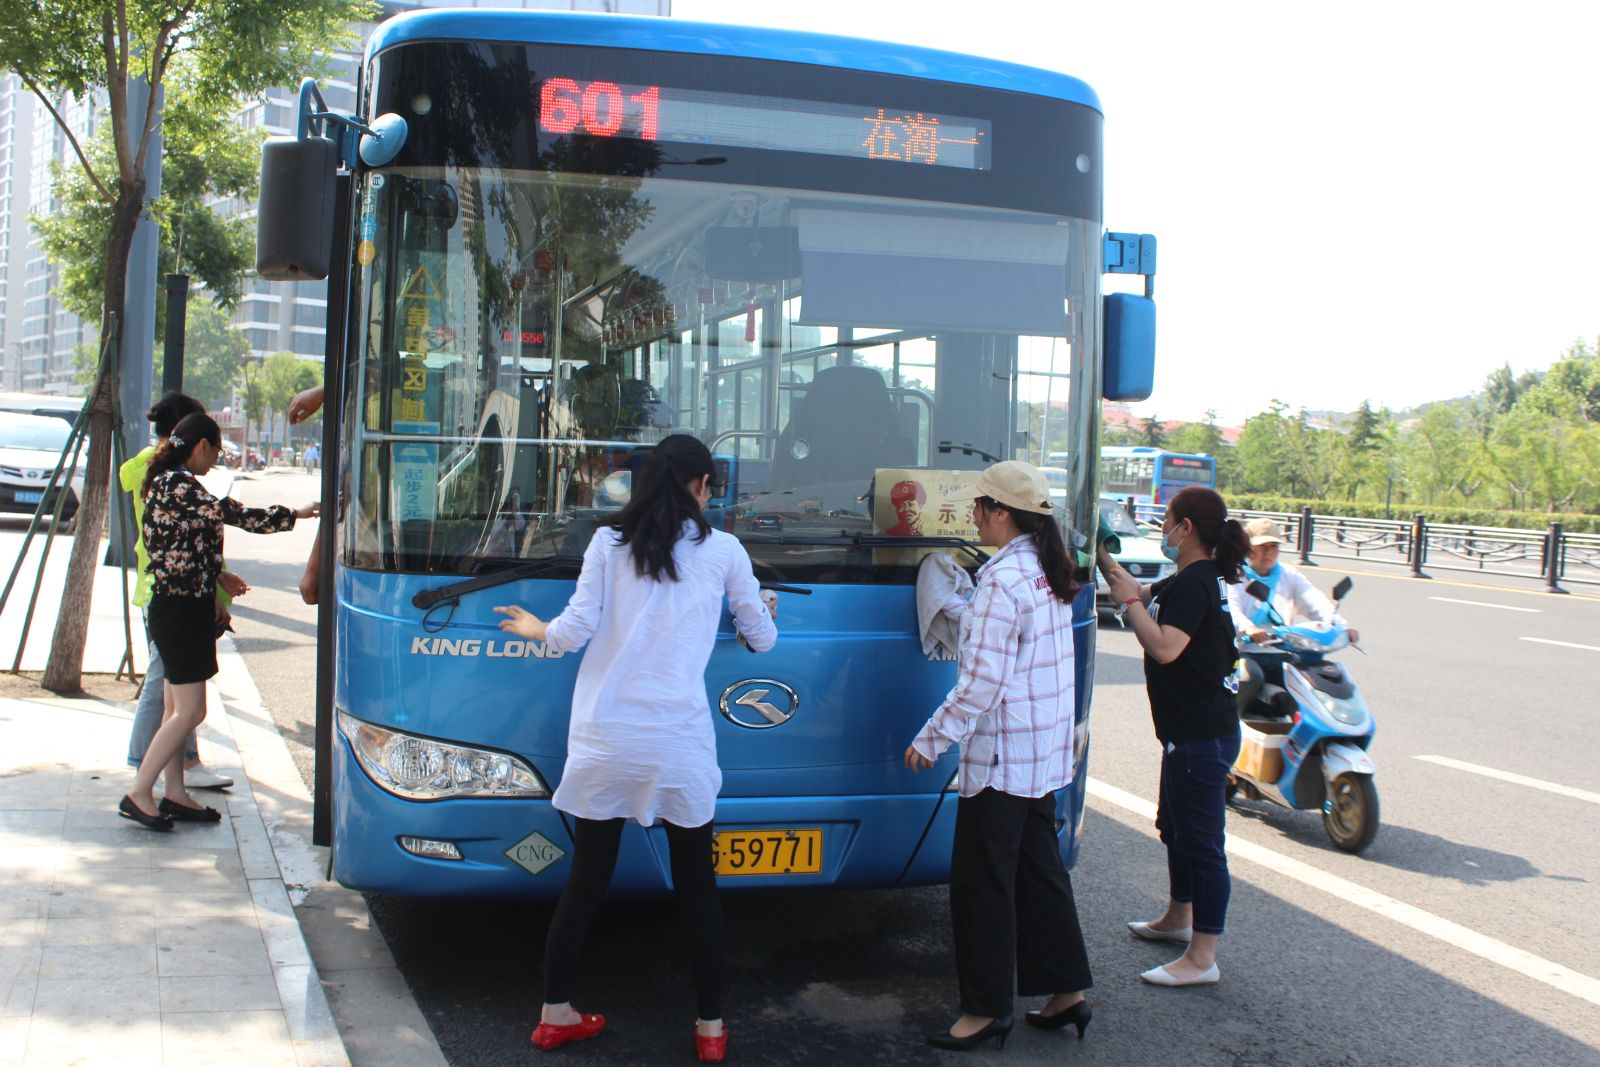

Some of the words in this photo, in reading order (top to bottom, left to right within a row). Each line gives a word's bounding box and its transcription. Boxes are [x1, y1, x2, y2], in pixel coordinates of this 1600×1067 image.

[540, 77, 660, 141] 601
[862, 108, 984, 165] 在海一
[411, 636, 482, 657] KING
[516, 845, 554, 862] CNG
